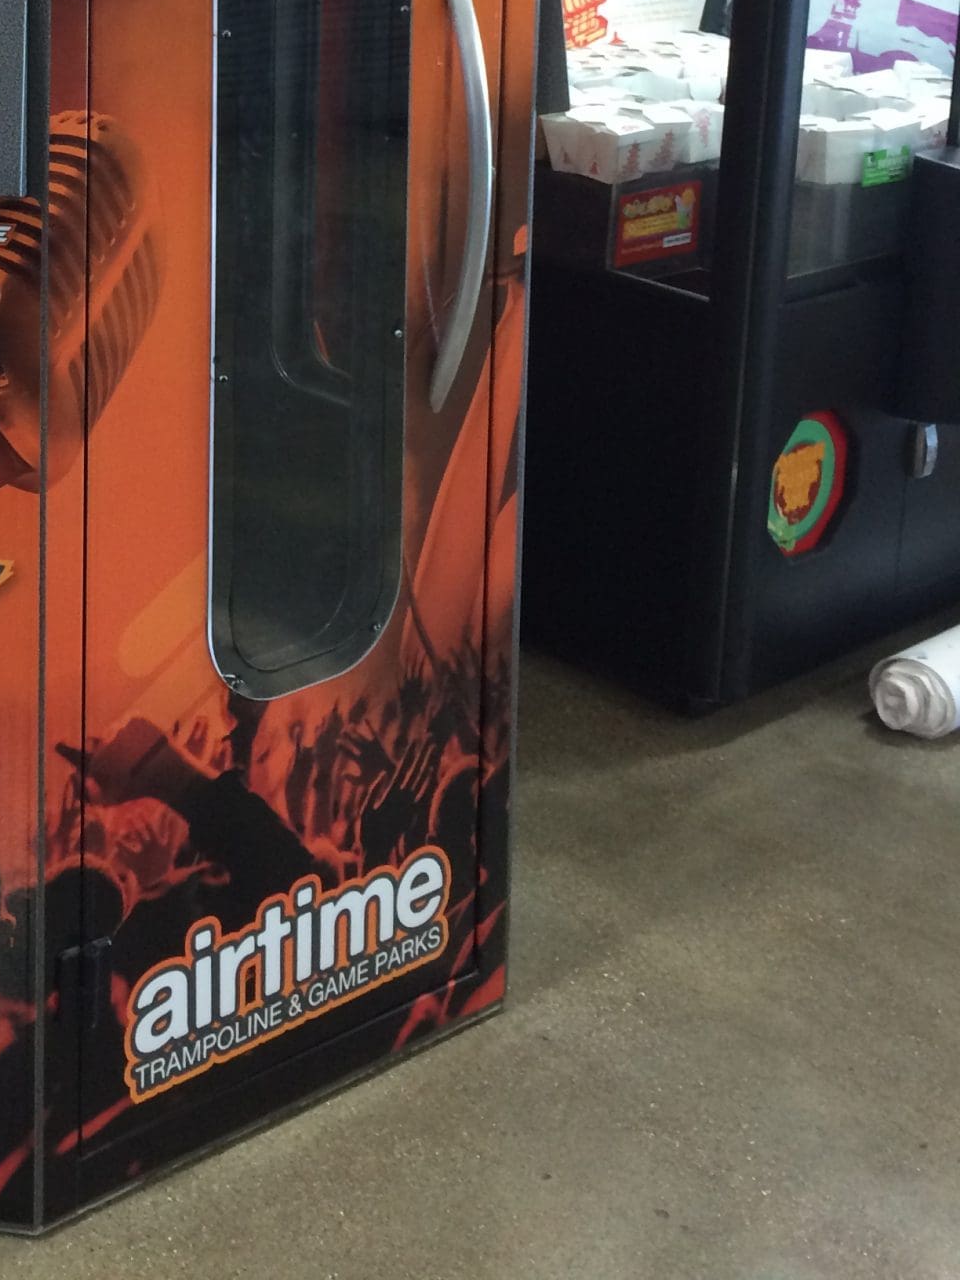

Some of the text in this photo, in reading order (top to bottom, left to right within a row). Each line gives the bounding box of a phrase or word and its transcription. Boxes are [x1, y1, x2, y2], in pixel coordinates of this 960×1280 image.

[134, 857, 444, 1054] airtime
[135, 926, 441, 1089] TRAMPOLINE & GAME PARKS
